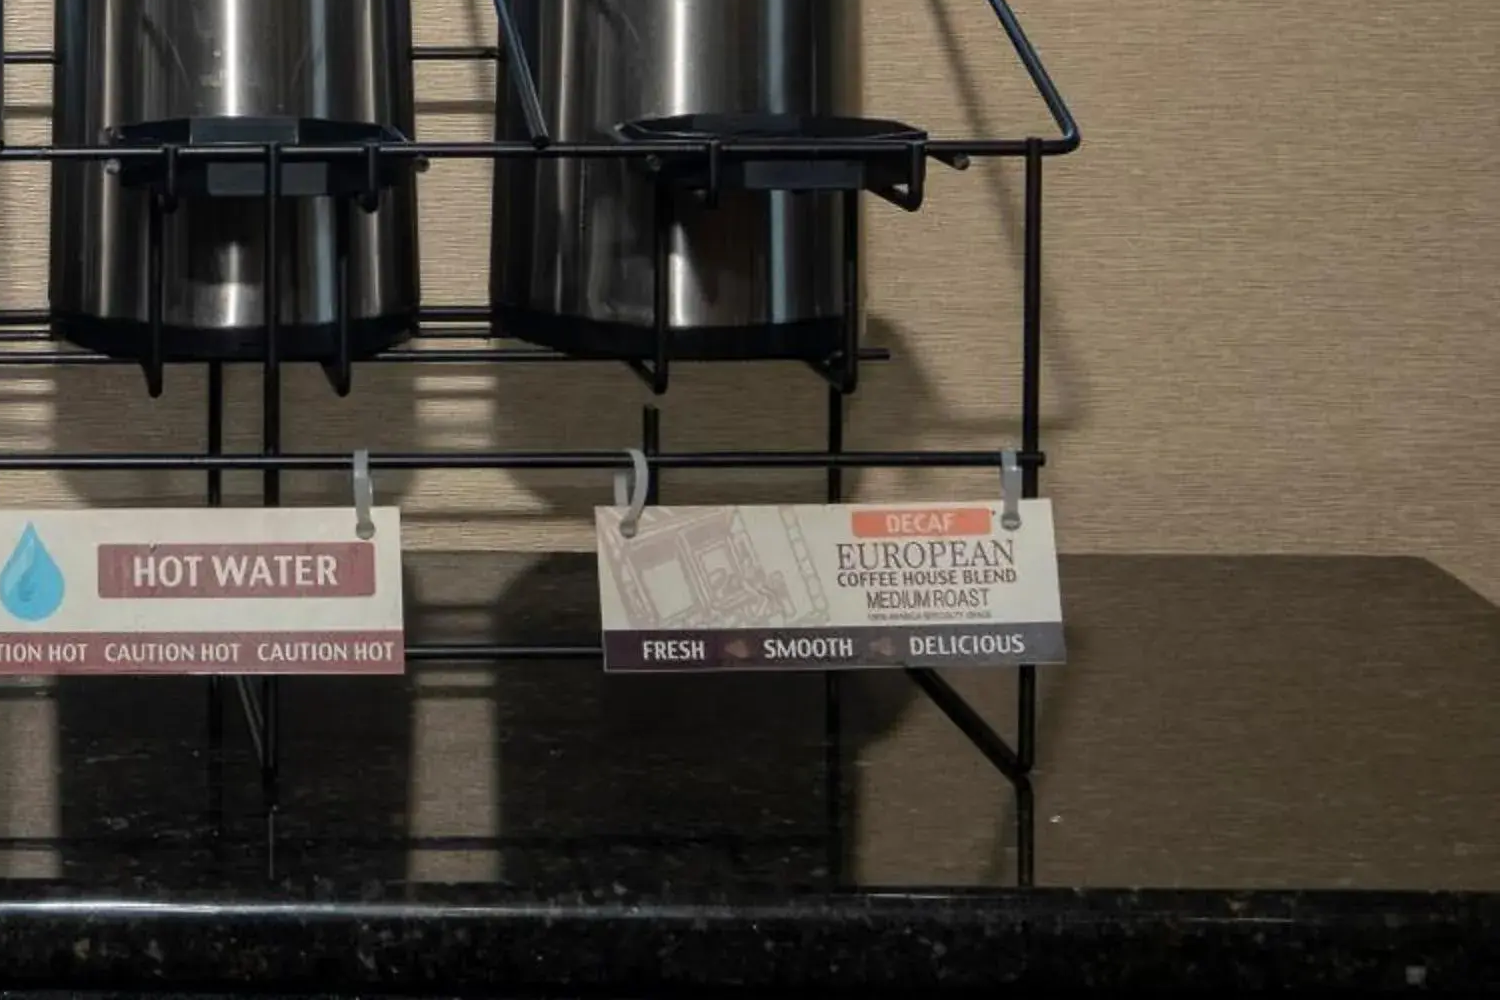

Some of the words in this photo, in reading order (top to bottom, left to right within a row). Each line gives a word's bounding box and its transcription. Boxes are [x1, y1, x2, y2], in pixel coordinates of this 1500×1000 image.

[886, 513, 956, 534] DECAF
[836, 539, 1015, 571] EUROPEAN
[133, 556, 202, 588] HOT
[212, 555, 339, 587] WATER
[837, 571, 898, 588] COFFEE
[902, 570, 957, 586] HOUSE
[963, 569, 1016, 585] BLEND
[866, 590, 931, 610] MEDIUM
[933, 588, 989, 608] ROAST
[48, 643, 89, 662] HOT
[104, 643, 195, 662] CAUTION
[201, 642, 242, 662] HOT
[257, 642, 347, 661] CAUTION
[354, 641, 395, 661] HOT
[643, 640, 705, 660] FRESH
[764, 638, 853, 658] SMOOTH
[909, 634, 1026, 656] DELICIOUS
